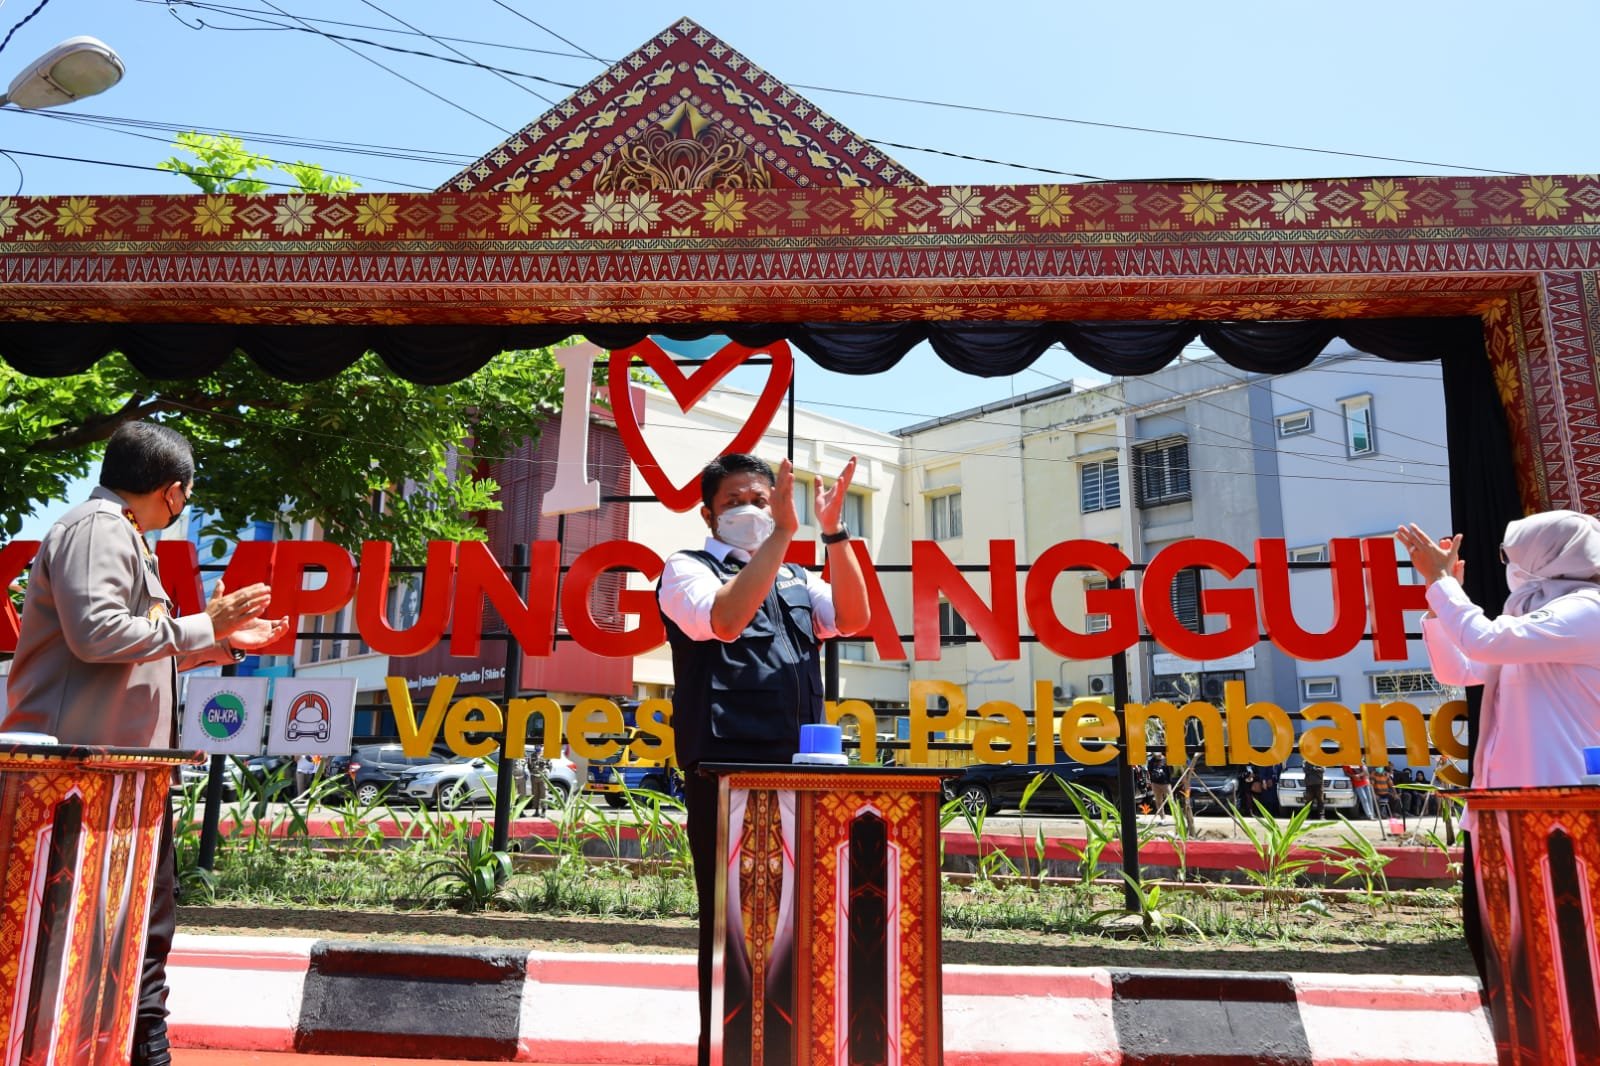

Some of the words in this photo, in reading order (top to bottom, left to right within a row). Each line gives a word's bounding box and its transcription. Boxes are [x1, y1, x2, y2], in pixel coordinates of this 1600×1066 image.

[542, 338, 603, 517] I
[208, 708, 238, 723] GN-KPA
[910, 679, 1469, 788] Palembang
